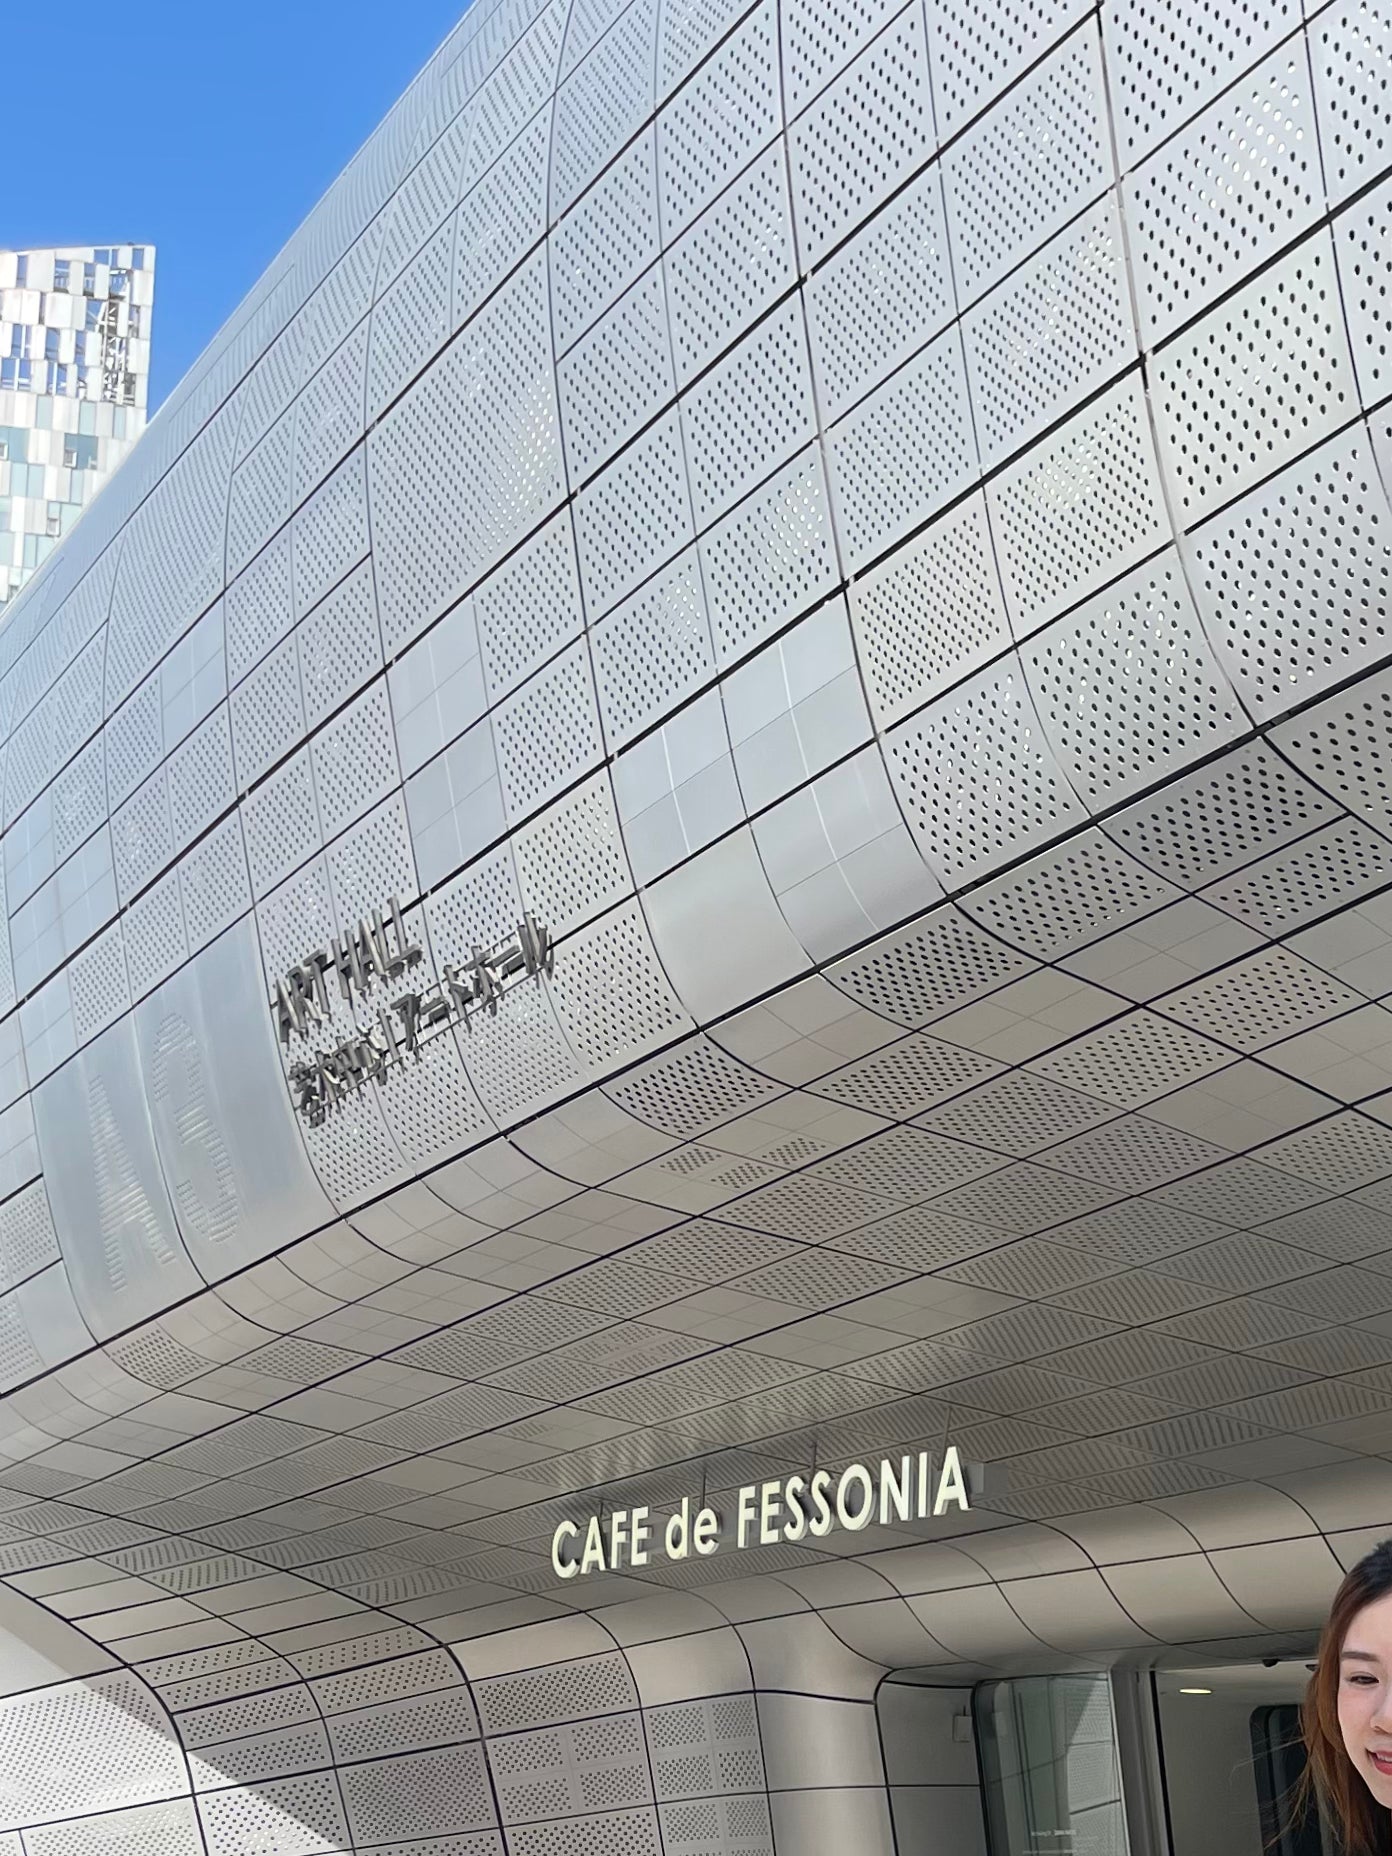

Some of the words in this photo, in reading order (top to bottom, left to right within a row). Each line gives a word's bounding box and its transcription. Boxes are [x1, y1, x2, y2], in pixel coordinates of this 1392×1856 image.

[276, 949, 332, 1044] ART
[329, 896, 423, 1000] HALL
[552, 1505, 652, 1578] CAFE
[665, 1497, 720, 1560] de
[737, 1446, 973, 1549] FESSONIA
